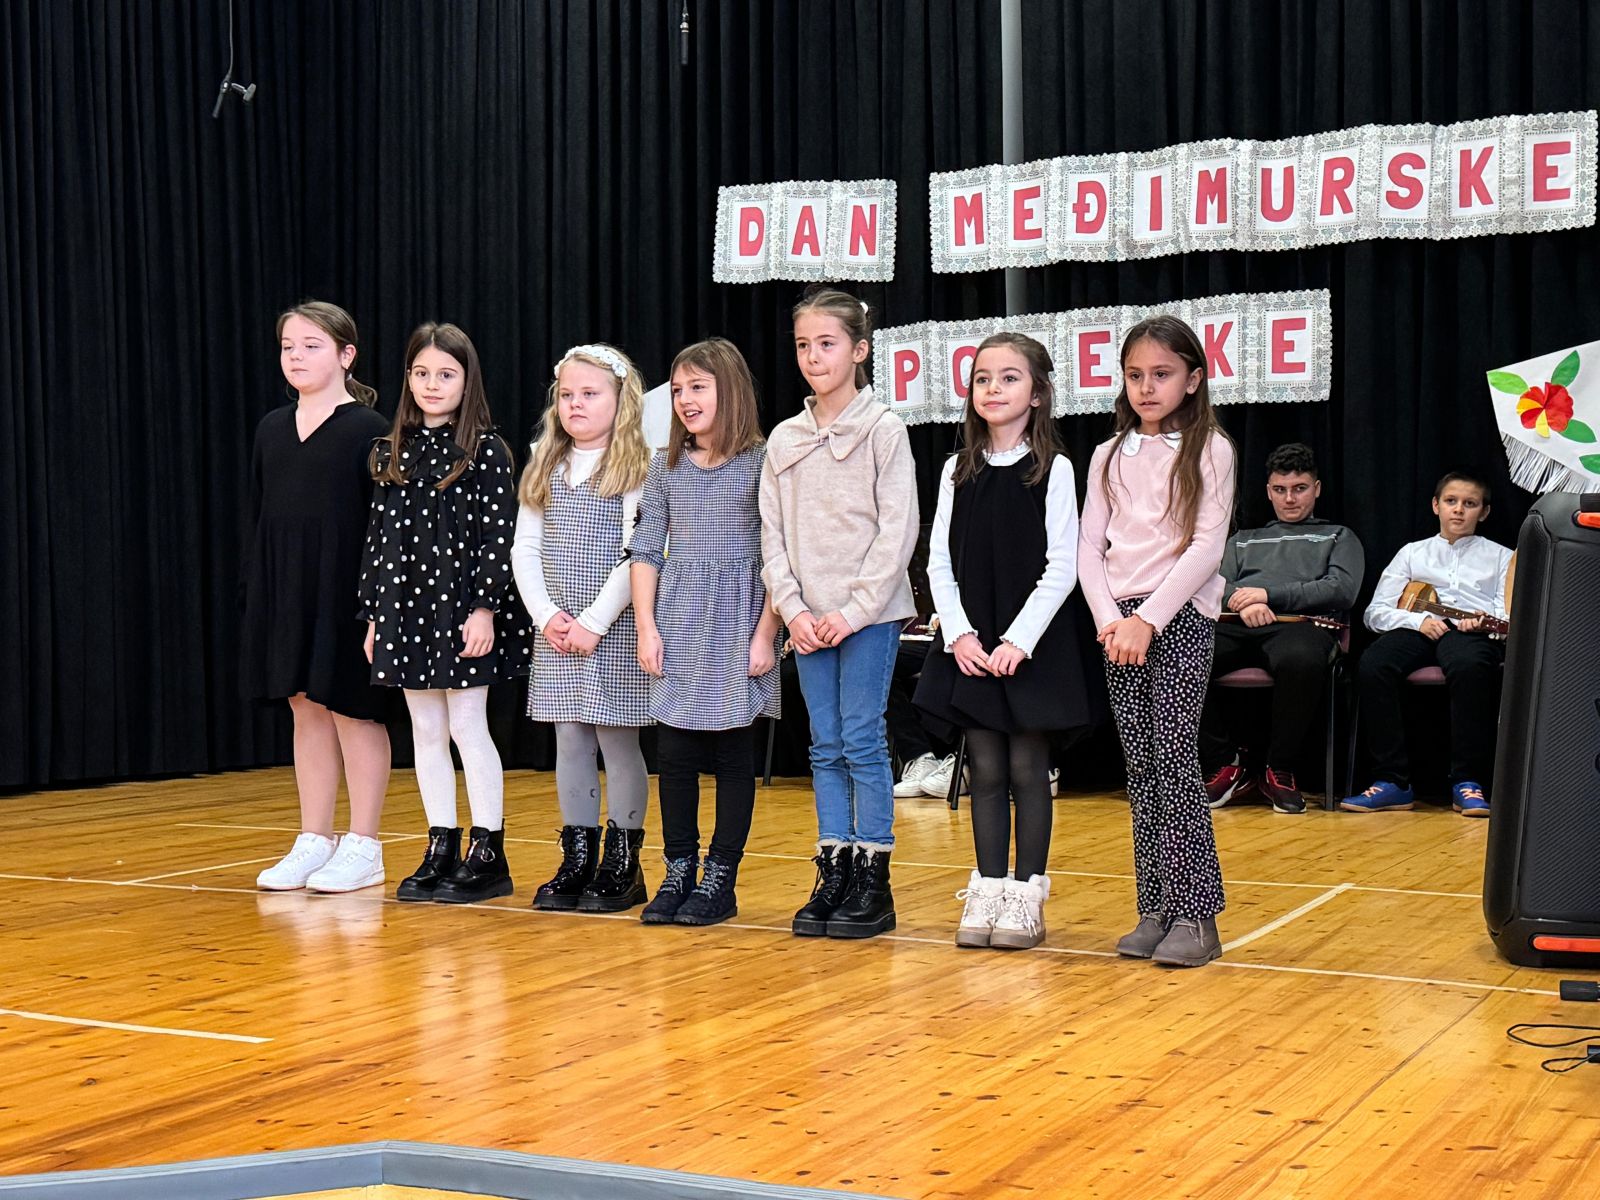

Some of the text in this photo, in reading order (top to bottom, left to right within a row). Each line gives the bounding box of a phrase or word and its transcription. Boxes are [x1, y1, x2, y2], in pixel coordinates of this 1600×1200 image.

[739, 141, 1571, 256] DAN MEĐIMURSKE
[894, 317, 1306, 402] POEKE
